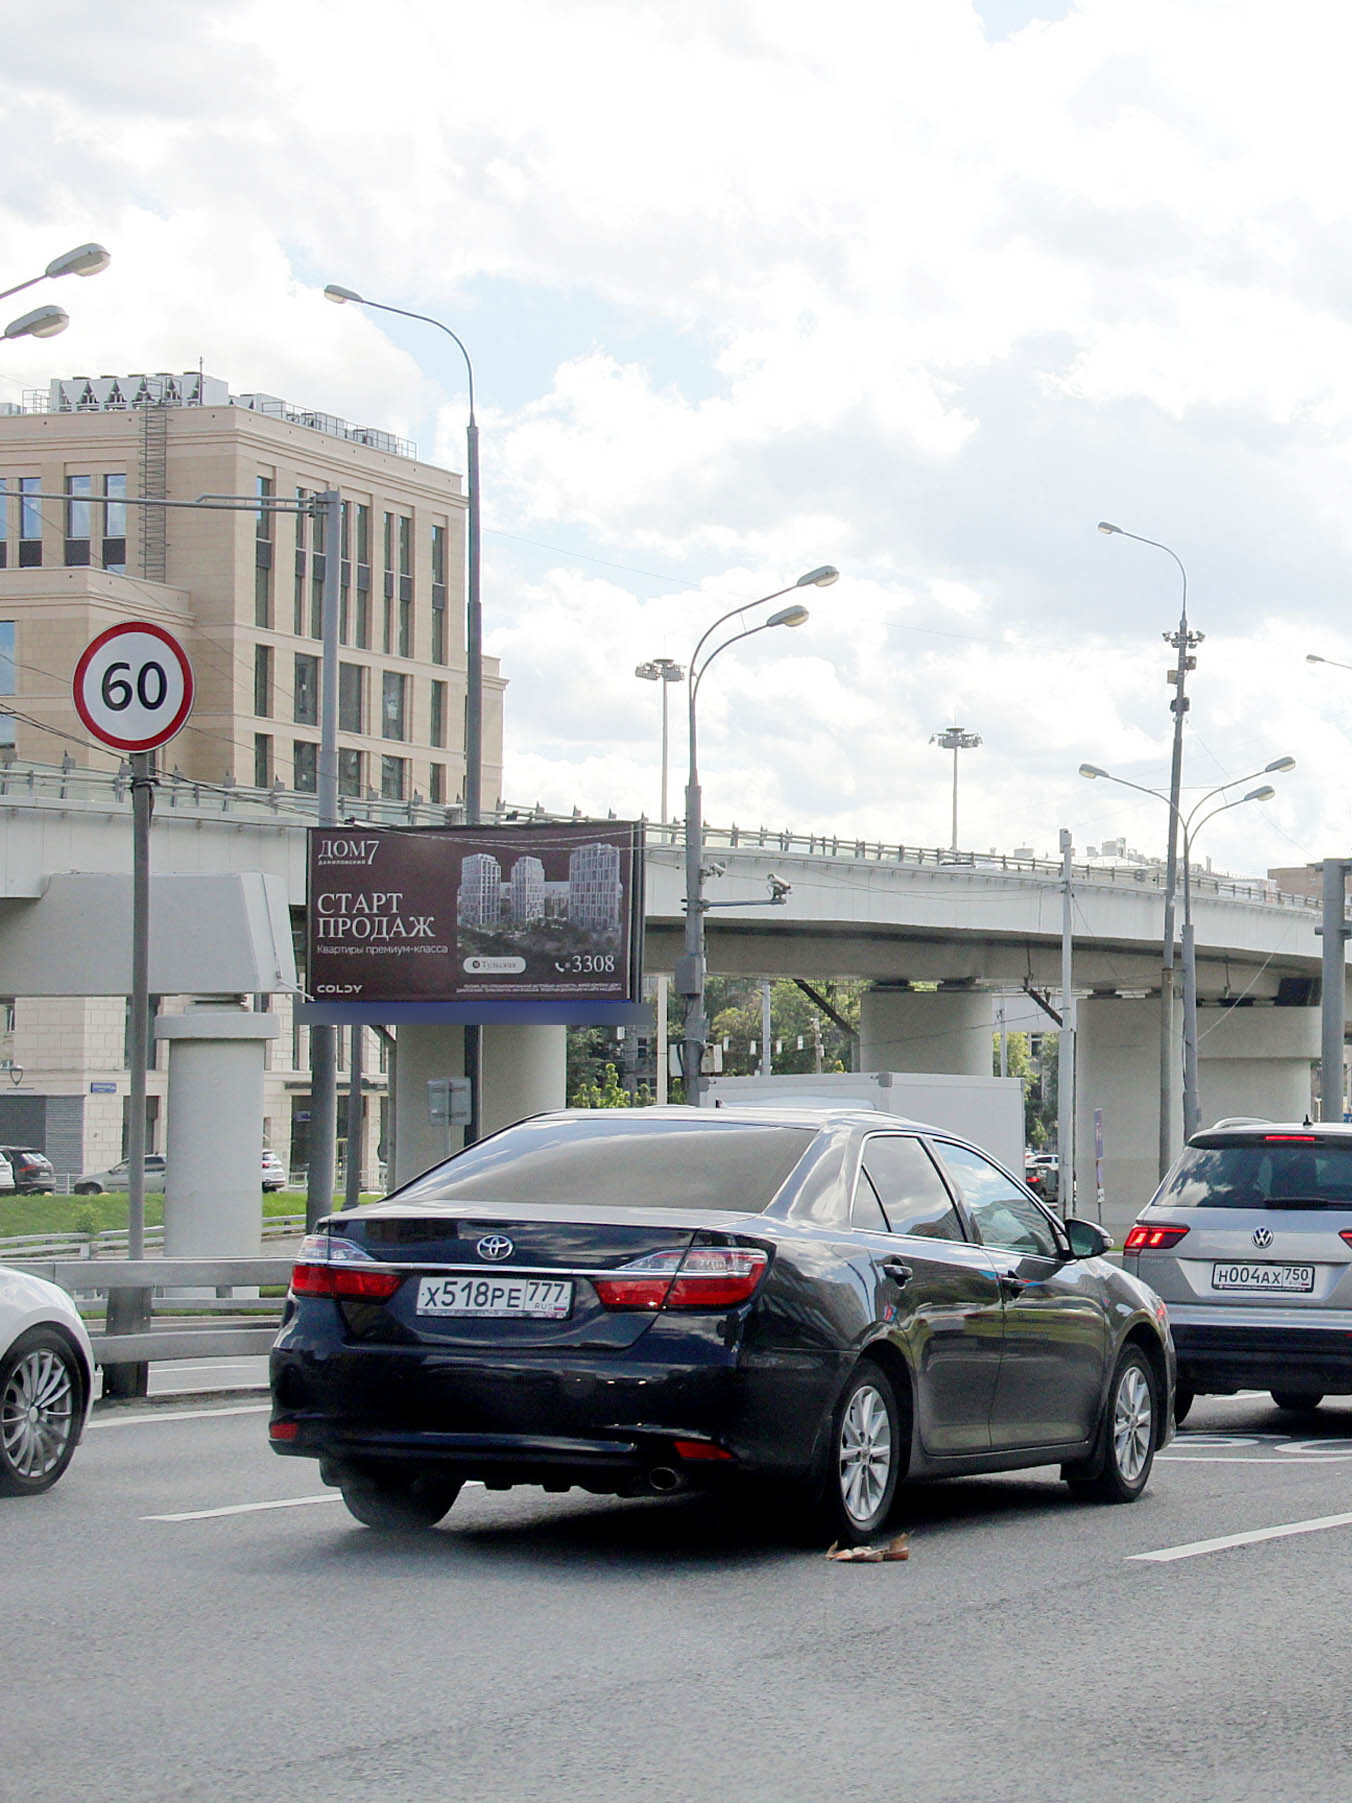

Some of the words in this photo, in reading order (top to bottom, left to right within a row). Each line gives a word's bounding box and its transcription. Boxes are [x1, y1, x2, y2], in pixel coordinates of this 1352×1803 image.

[101, 661, 168, 712] 60
[317, 893, 404, 914] СТАРТ
[317, 916, 437, 942] ПРОДАЖ
[1218, 1266, 1282, 1284] Н004АХ
[424, 1280, 522, 1308] Х518РЕ
[528, 1281, 566, 1303] 777
